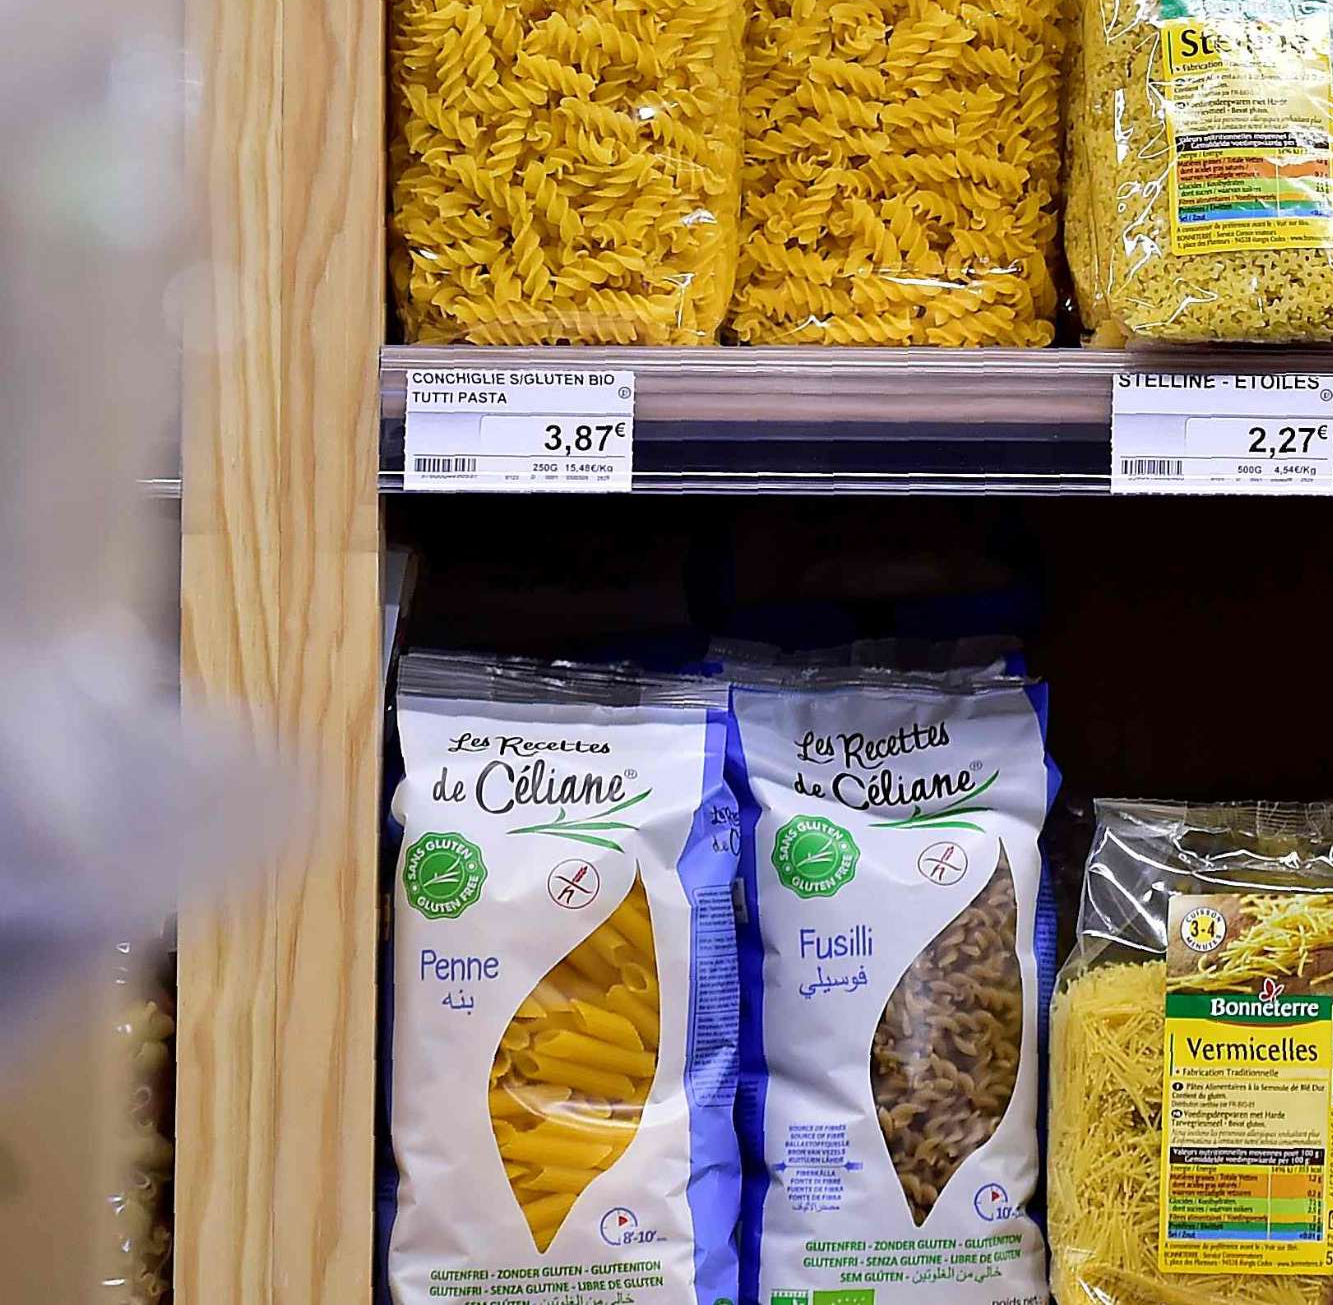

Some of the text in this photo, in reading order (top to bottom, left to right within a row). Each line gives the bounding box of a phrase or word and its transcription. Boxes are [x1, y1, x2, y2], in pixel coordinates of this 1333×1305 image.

[412, 372, 614, 385] CONCHIGLIE S/GLUTEN BIO
[412, 392, 507, 404] TUTTI PASTA
[1274, 466, 1316, 476] 4,54€/Kg
[448, 732, 611, 758] Les Recettes
[836, 722, 951, 770] Recettes
[433, 759, 626, 814] de Céliane
[832, 768, 976, 810] Céliane
[800, 924, 873, 959] Fusilli
[1190, 919, 1215, 939] 3-4
[421, 949, 499, 982] Penne
[1210, 998, 1319, 1018] Bonneterre
[1187, 1037, 1318, 1063] Vermicelles
[431, 1270, 489, 1281] GLUTENFREI
